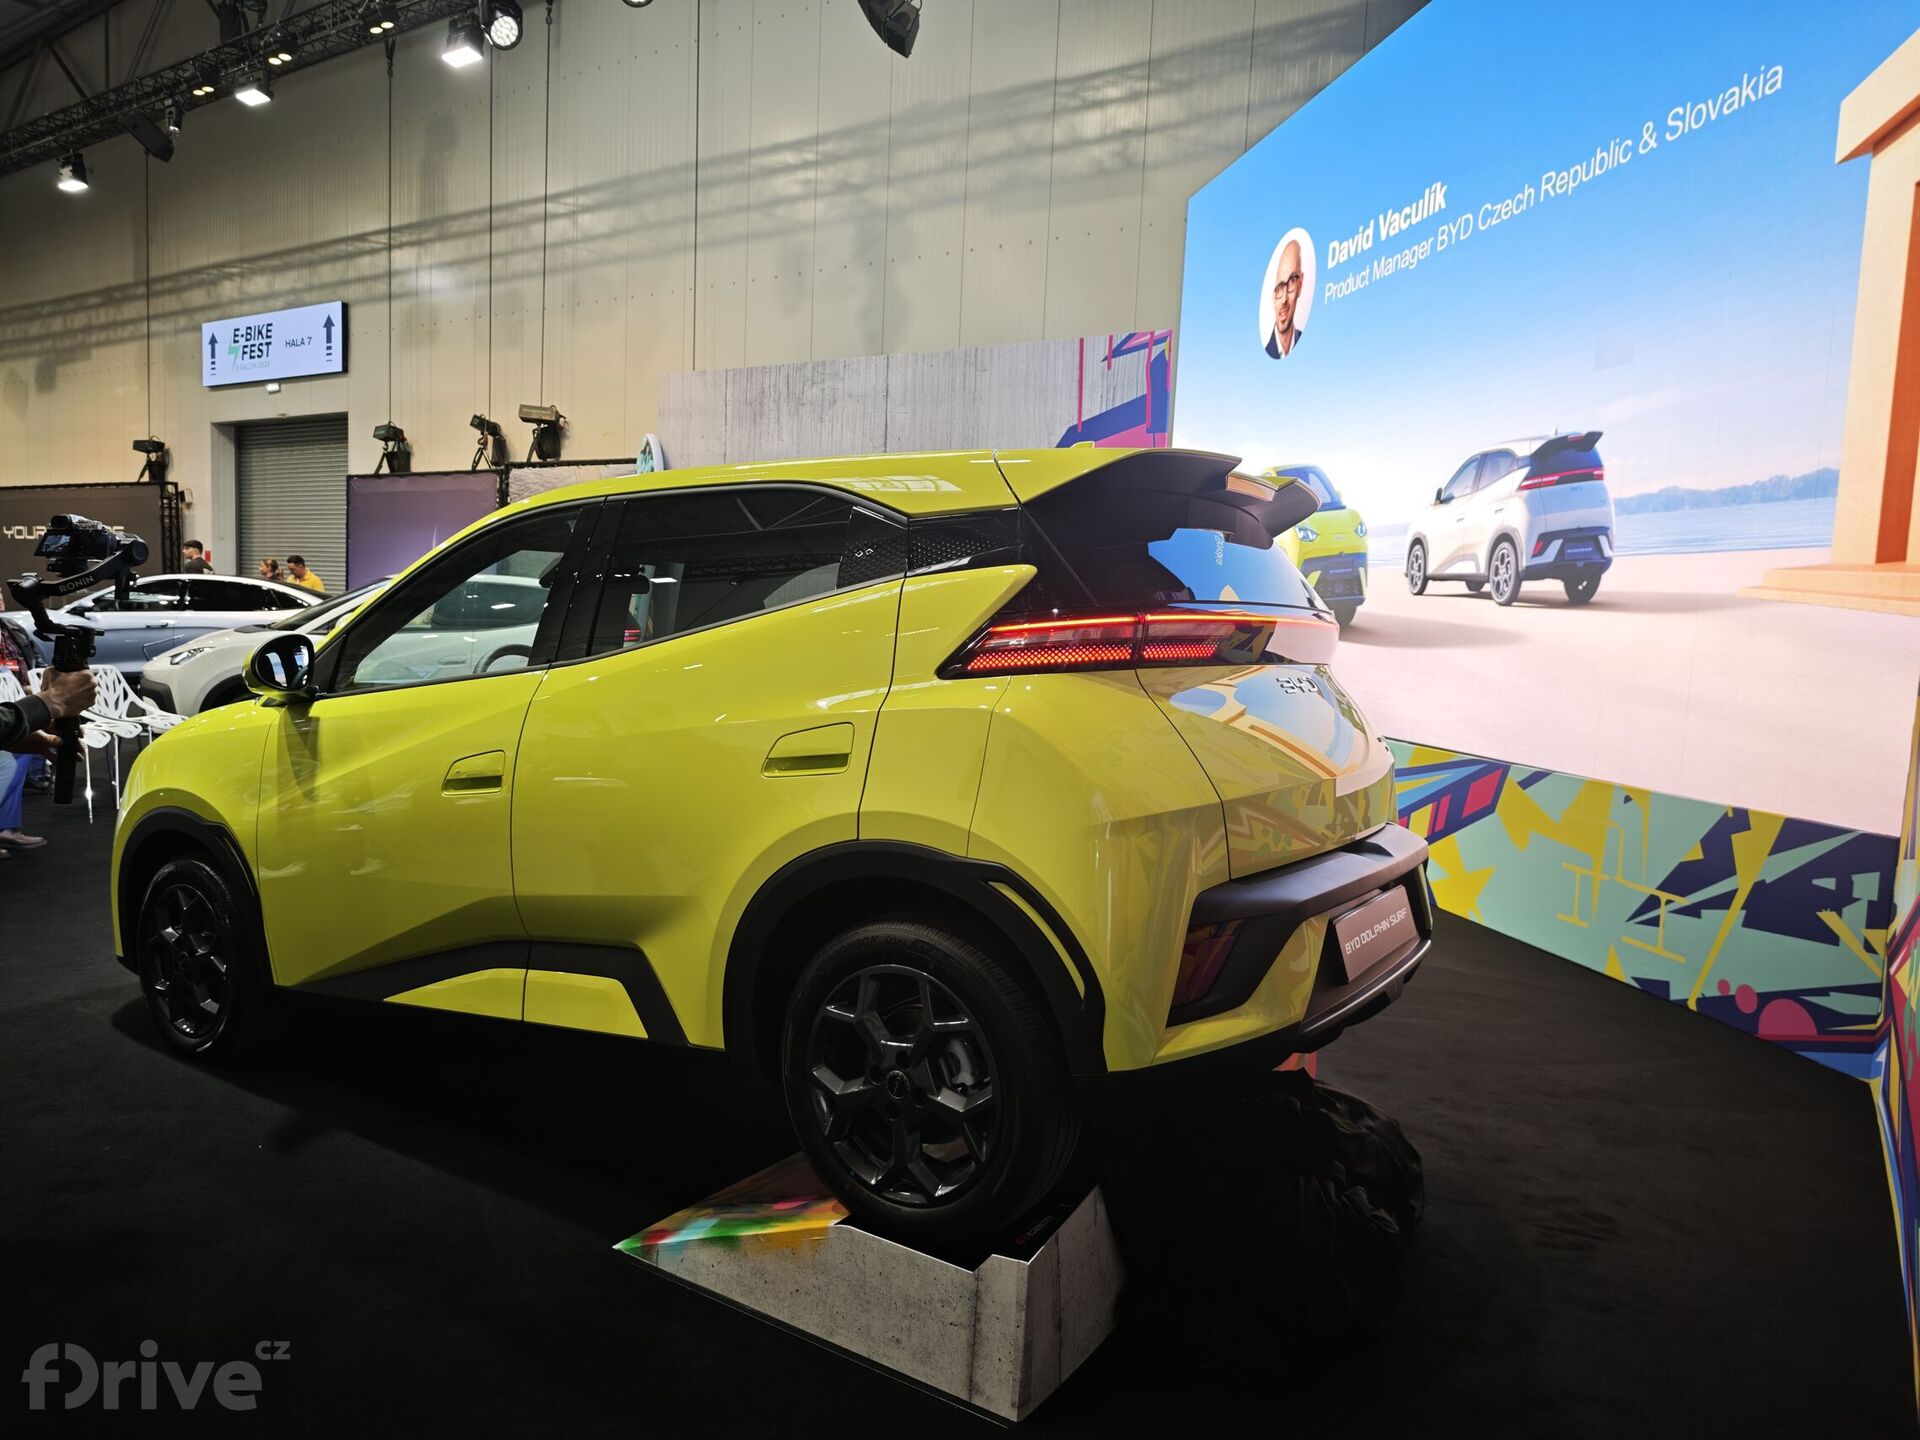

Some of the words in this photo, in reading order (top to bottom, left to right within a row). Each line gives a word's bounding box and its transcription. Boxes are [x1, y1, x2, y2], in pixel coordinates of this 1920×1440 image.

[1324, 264, 1370, 304] Product
[1372, 237, 1434, 282] Manager
[1436, 213, 1473, 252] BYD
[1478, 183, 1534, 231] Czech
[1540, 138, 1632, 202] Republic
[1638, 121, 1657, 154] &
[1665, 64, 1783, 141] Slovakia
[1327, 219, 1374, 269] David
[1379, 181, 1448, 241] Vaculík
[233, 323, 273, 344] E-BIKE
[285, 337, 305, 348] HALA
[307, 337, 312, 345] 7
[241, 342, 272, 361] FEST
[3, 526, 47, 539] YOUR
[59, 576, 94, 592] RONIN
[1344, 936, 1361, 954] BYD
[1360, 920, 1390, 945] DOLPHIN
[1390, 907, 1408, 926] SURF
